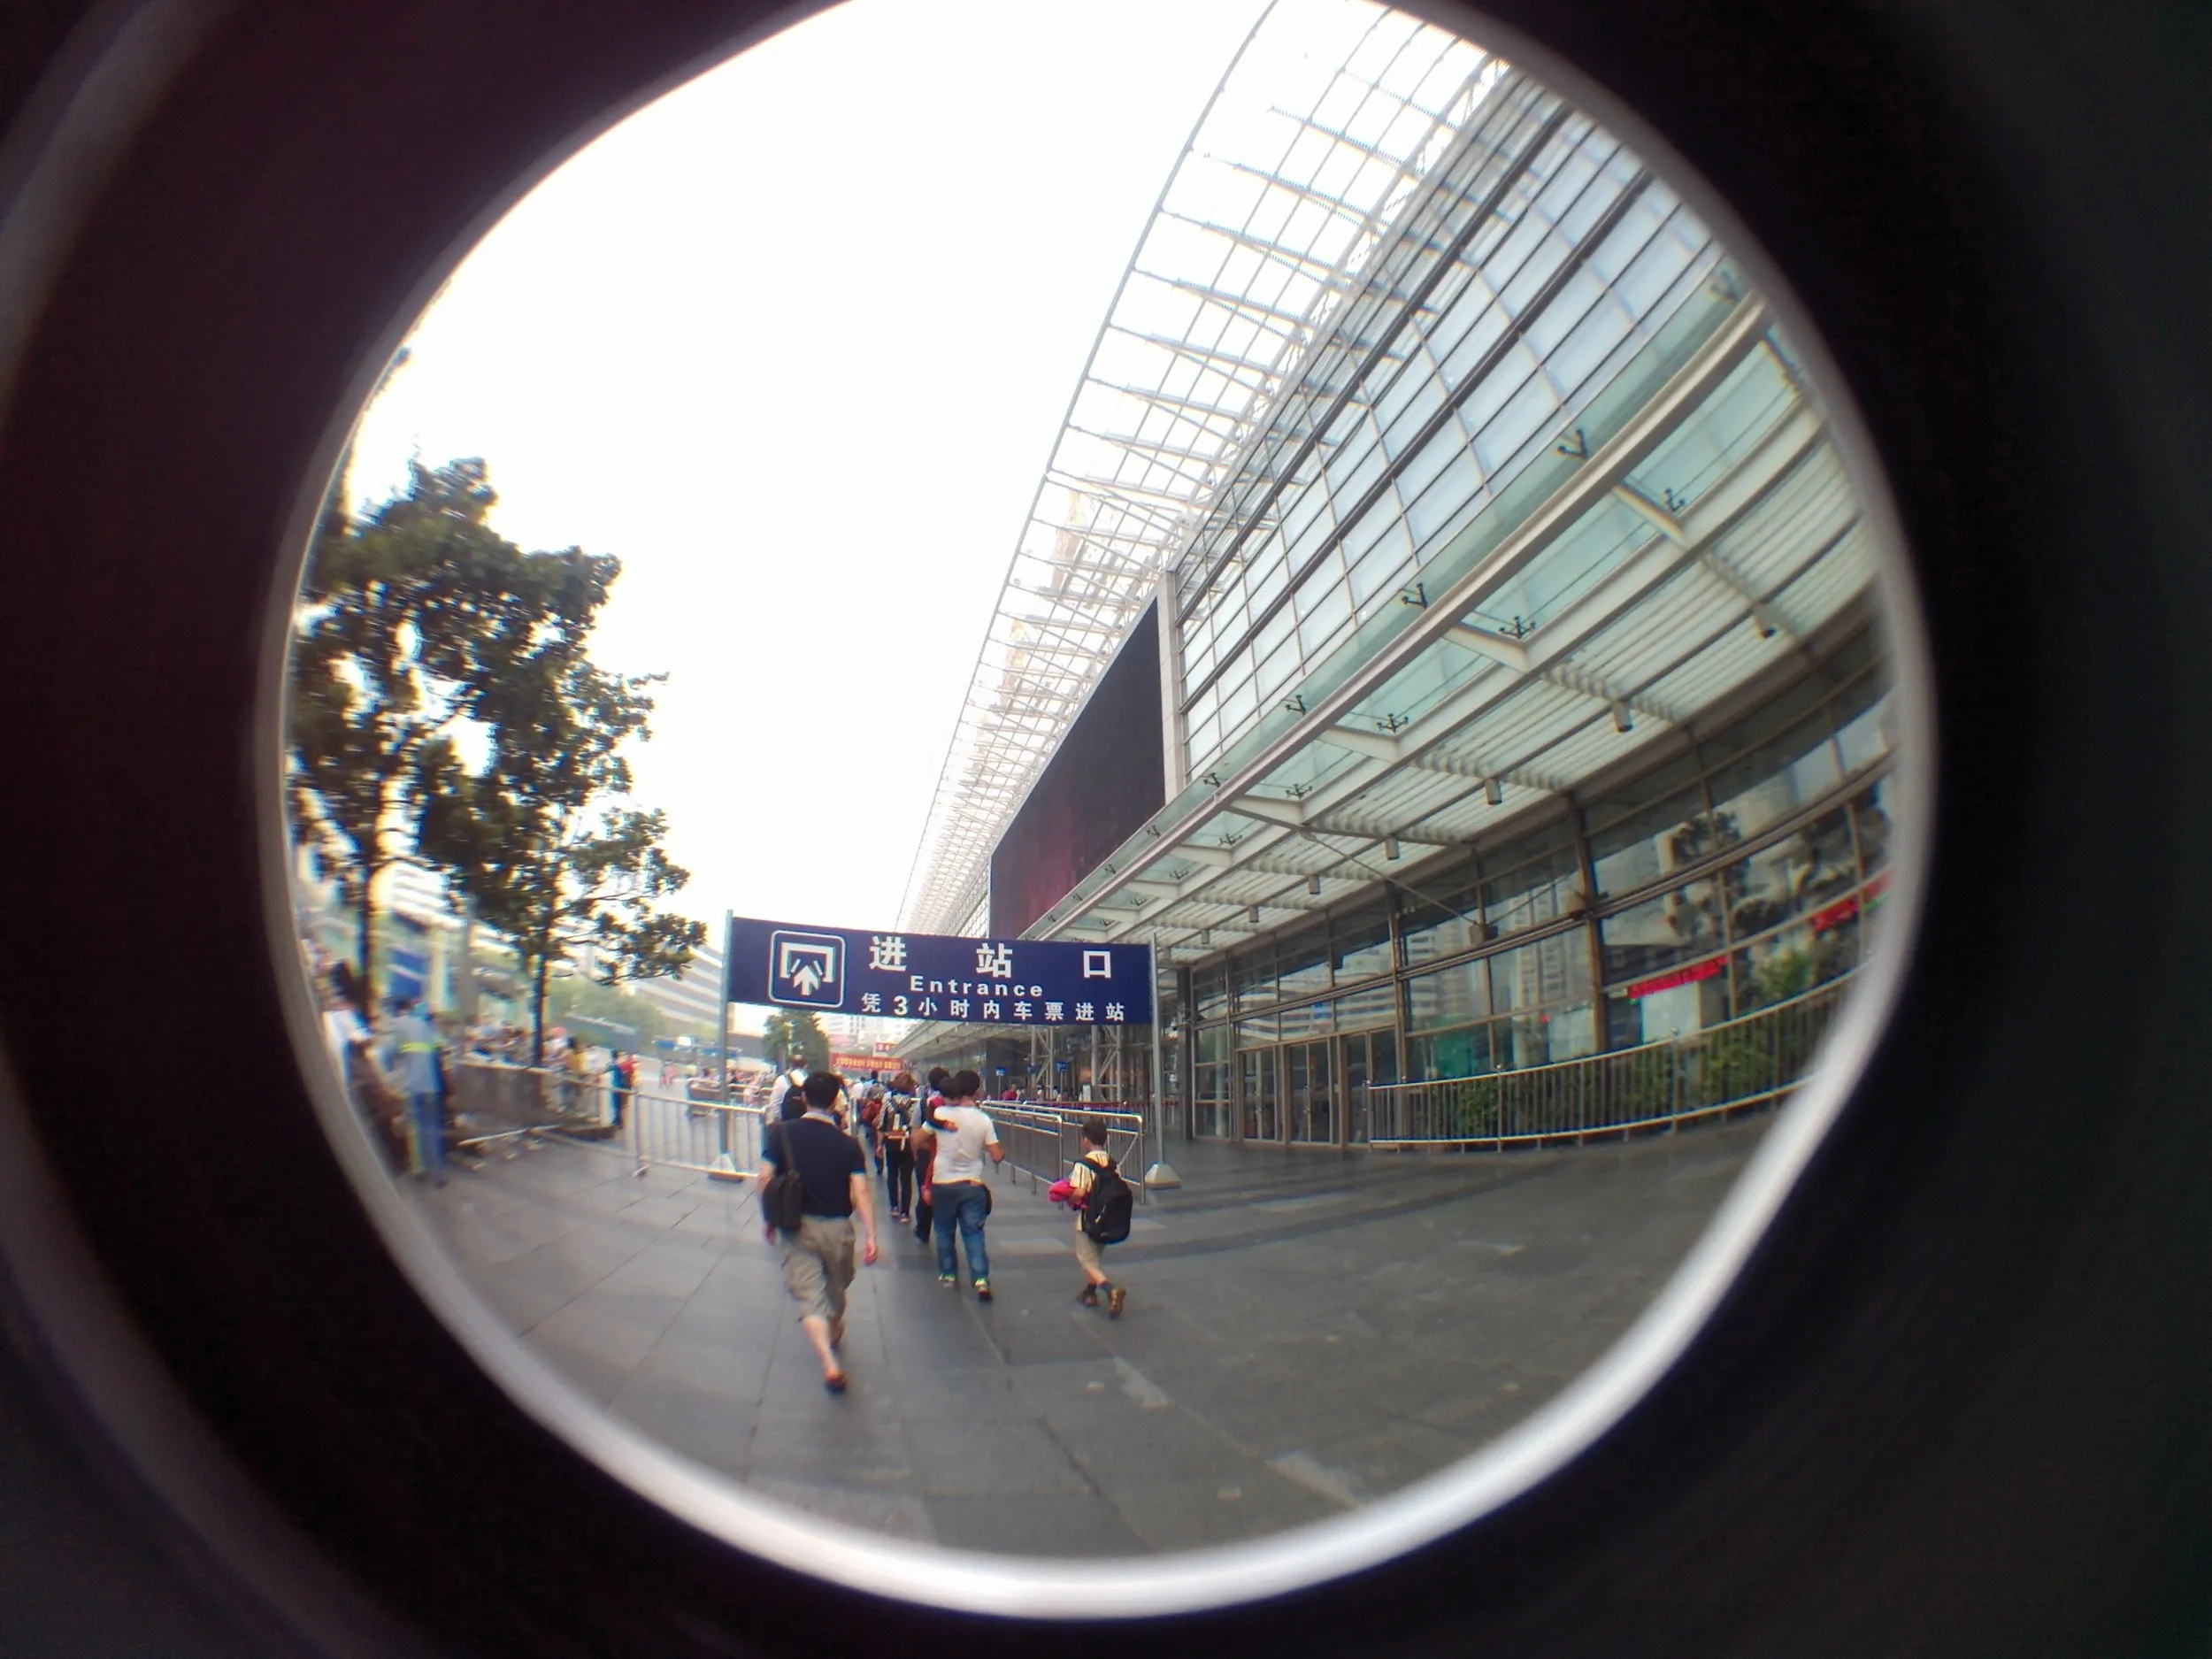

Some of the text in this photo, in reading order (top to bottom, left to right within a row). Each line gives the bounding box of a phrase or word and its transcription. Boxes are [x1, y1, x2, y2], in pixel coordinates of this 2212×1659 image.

[870, 936, 1111, 978] 进站口
[910, 975, 1043, 997] Entrance
[862, 993, 1125, 1021] 凭3小时内车票进站
